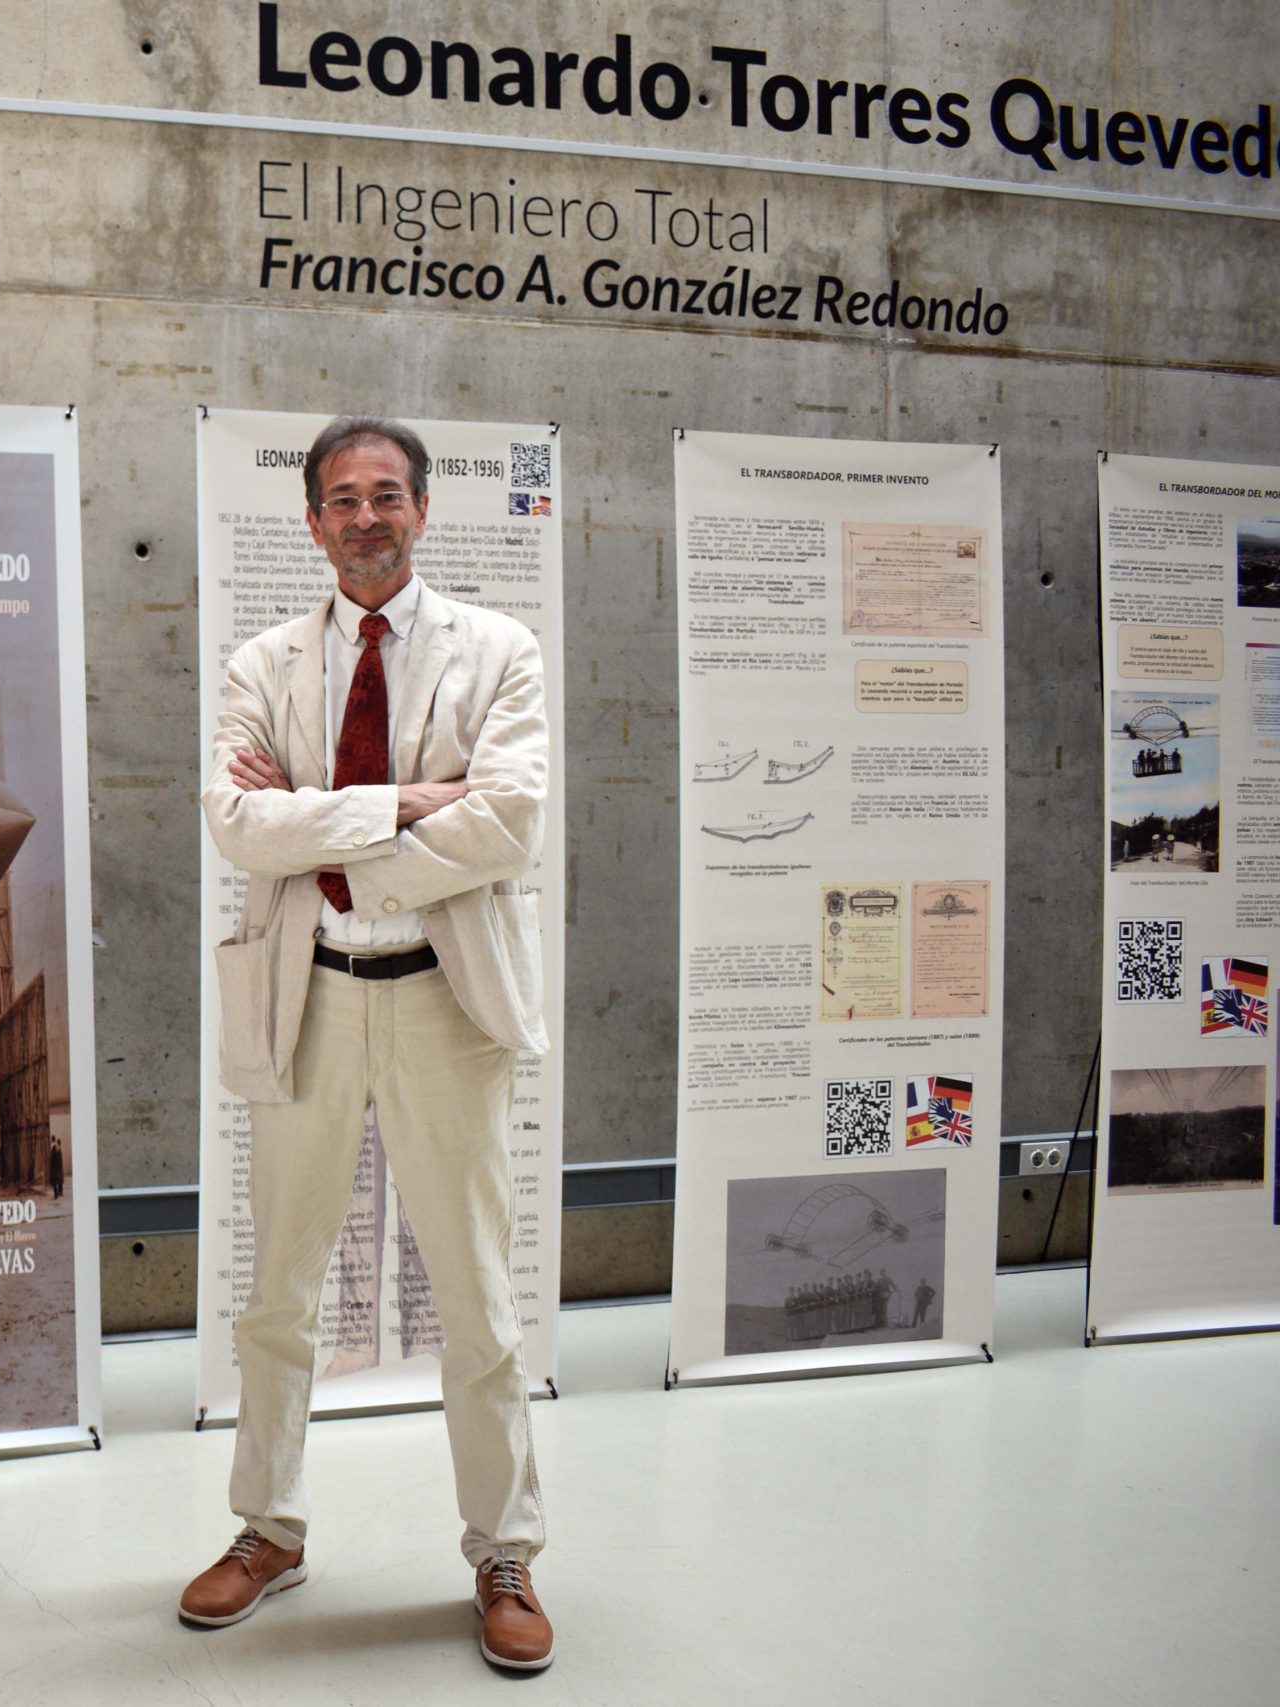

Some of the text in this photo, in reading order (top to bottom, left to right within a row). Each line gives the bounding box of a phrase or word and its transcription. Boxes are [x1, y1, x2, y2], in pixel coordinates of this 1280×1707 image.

[258, 3, 1280, 180] Leonardo Torres Queved
[258, 159, 771, 254] El Ingeniero Total
[259, 237, 1009, 337] Francisco A. González Redondo
[256, 449, 308, 468] LEONAR
[435, 460, 505, 480] (1852-1936)
[740, 467, 929, 485] EL TRANSBORDADOR, PRIMER INVENTO
[1159, 482, 1169, 492] EL
[1170, 484, 1246, 497] TRANSBORDADOR
[1247, 489, 1263, 498] DEL
